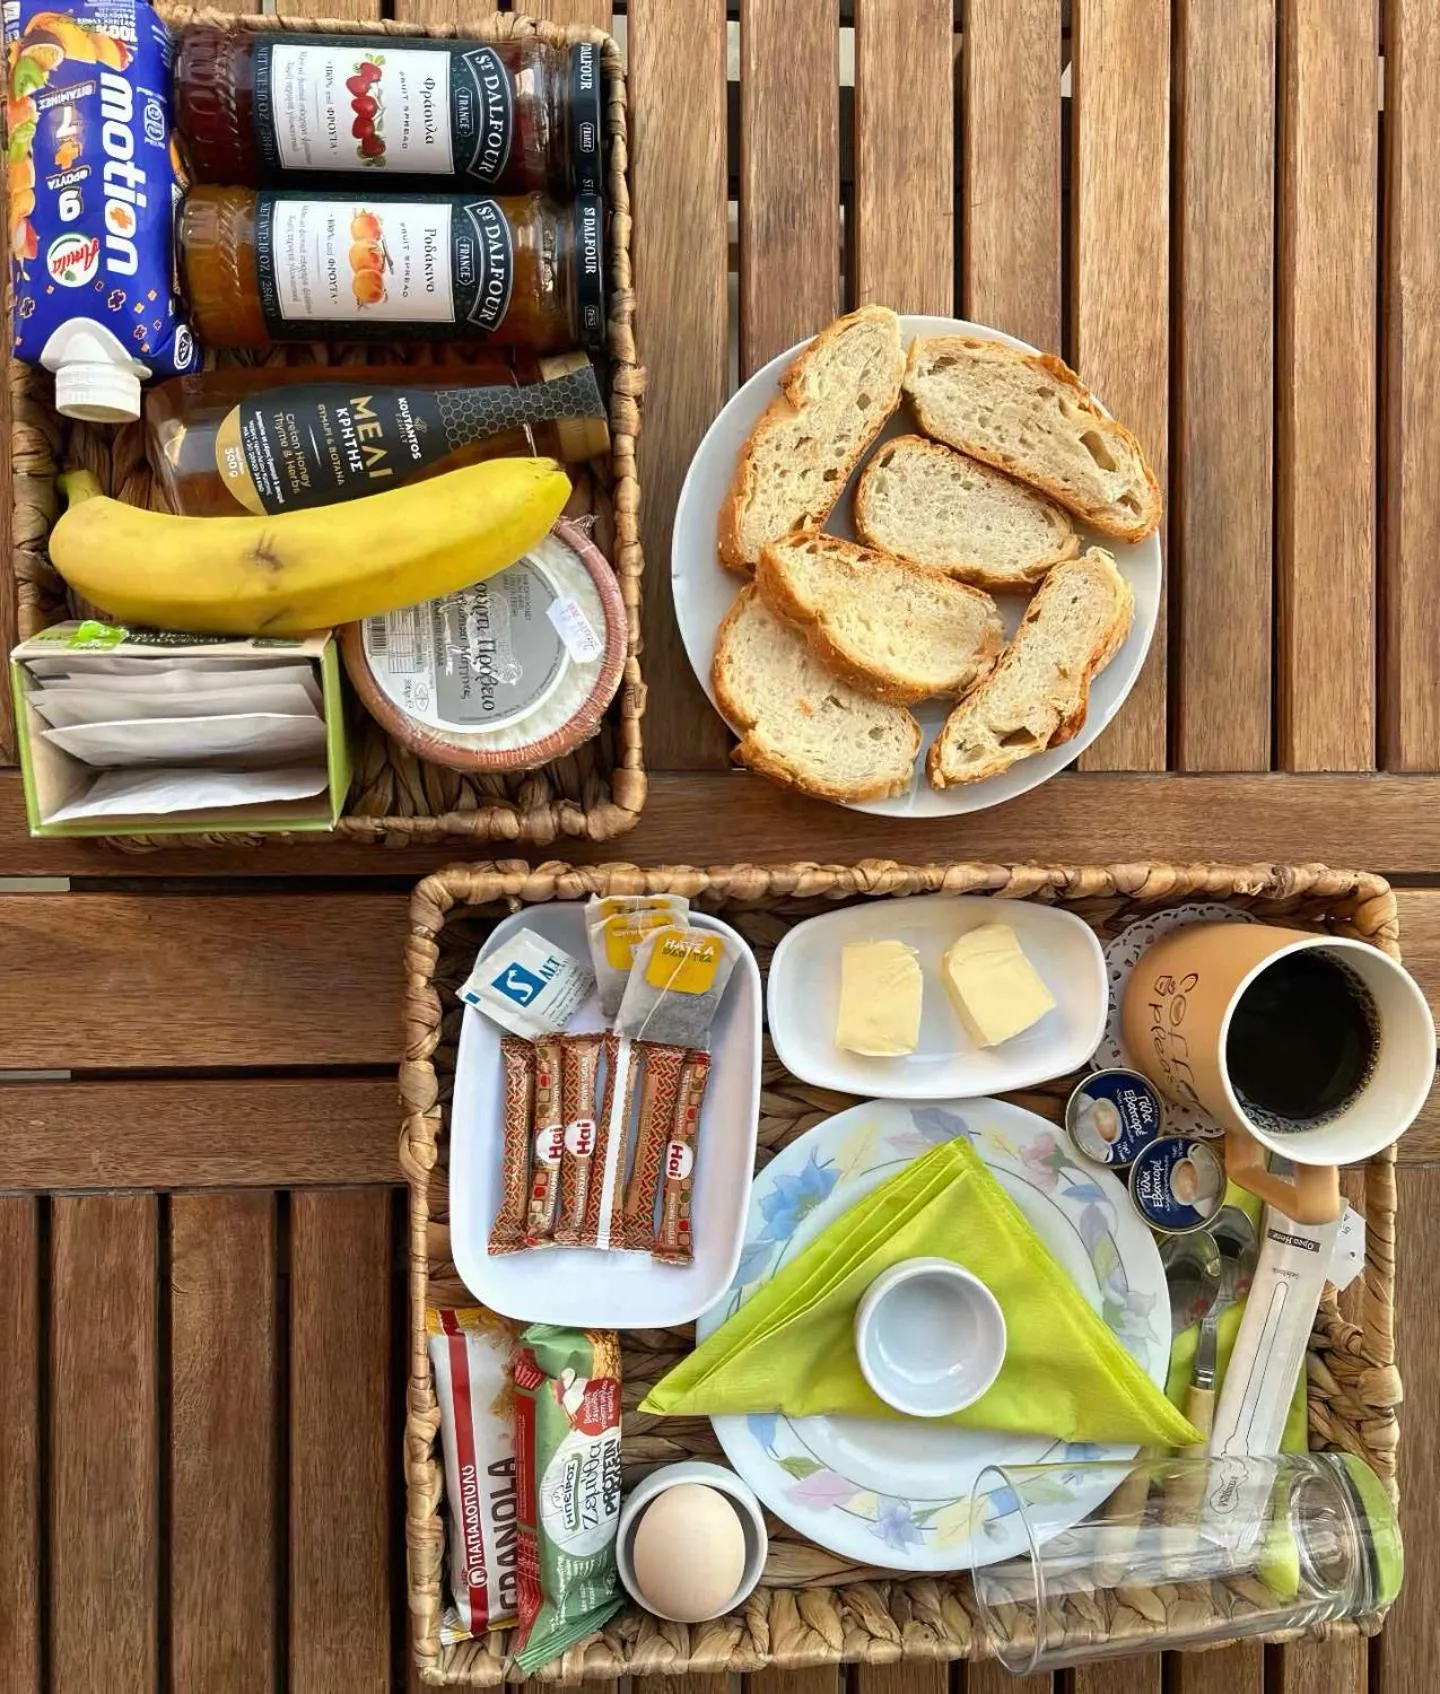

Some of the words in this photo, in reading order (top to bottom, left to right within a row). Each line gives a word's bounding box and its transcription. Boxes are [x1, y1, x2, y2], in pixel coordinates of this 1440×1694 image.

[475, 54, 495, 71] ST
[419, 77, 440, 145] Φράουλα
[458, 94, 471, 130] FRANCE
[478, 77, 504, 174] DALFOUR
[100, 72, 148, 276] motion
[476, 205, 496, 222] ST
[424, 229, 437, 293] Ροδάκινο
[459, 243, 471, 279] FRANCE
[478, 226, 505, 321] DALFOUR
[583, 218, 598, 275] DALFOUR
[285, 413, 301, 449] Cretan
[295, 450, 312, 489] Honey
[336, 407, 364, 473] ΚΡΗΤΗΣ
[350, 395, 393, 478] ΜΕΛΙ
[397, 397, 421, 460] KOUTANTOS
[1123, 1089, 1147, 1136] Εβαπορέ
[1137, 1090, 1153, 1123] Γάλα
[549, 1127, 563, 1159] Hai
[576, 1121, 591, 1154] Hai
[667, 1144, 684, 1178] Hai
[1153, 1159, 1164, 1208] Εβαπορέ
[564, 1463, 576, 1527] ΗΠΕΙΡΟΣ
[602, 1438, 618, 1517] PROTEIN
